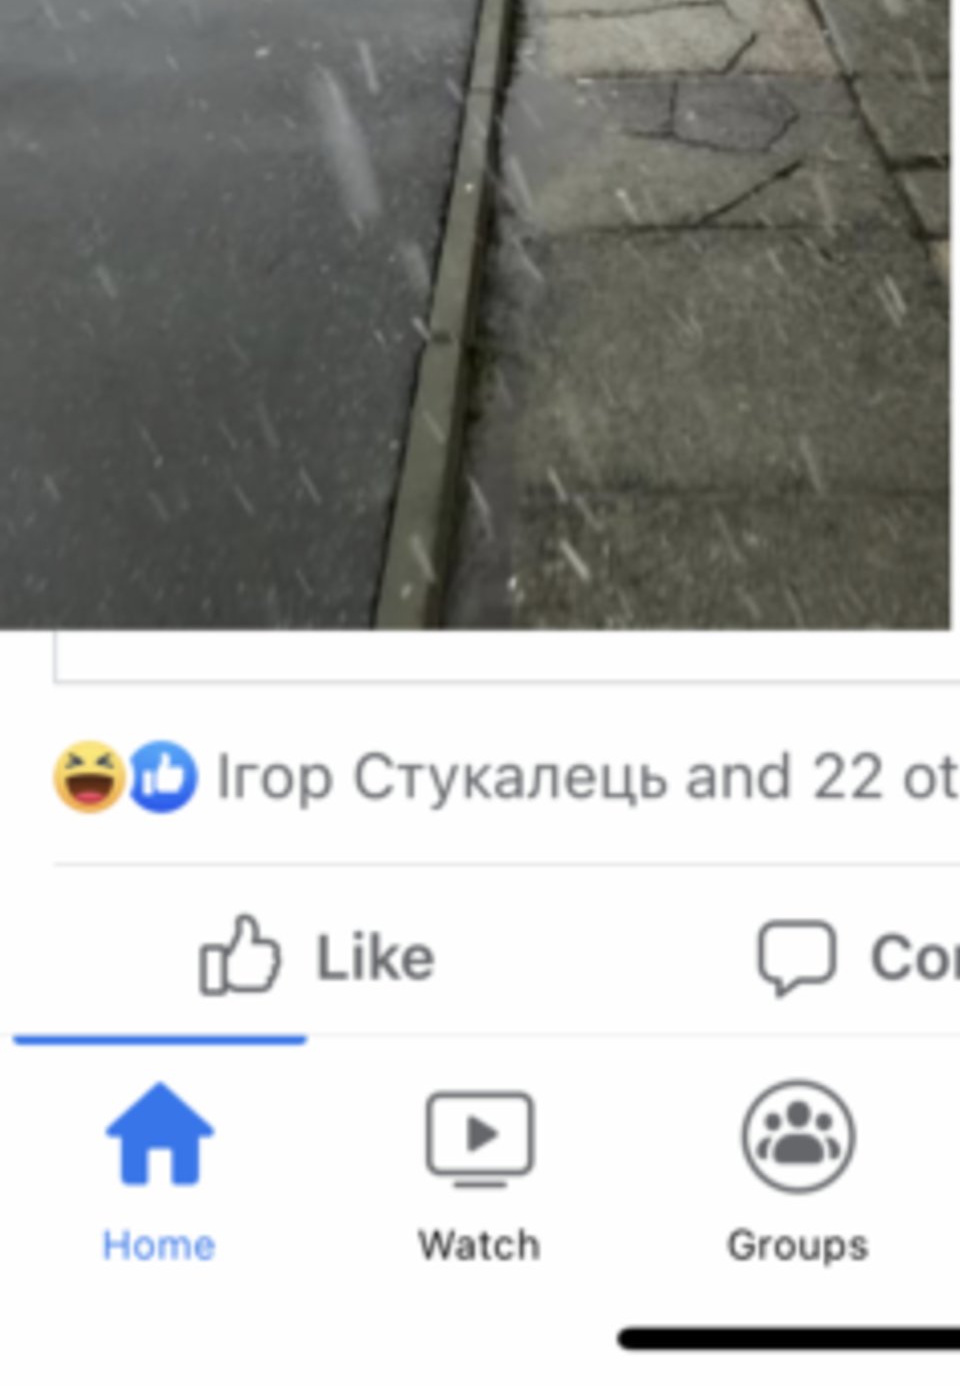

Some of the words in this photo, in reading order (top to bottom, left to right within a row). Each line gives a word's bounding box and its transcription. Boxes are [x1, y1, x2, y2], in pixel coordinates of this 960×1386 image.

[219, 752, 334, 810] Ігор
[354, 751, 668, 811] Стукалець
[686, 751, 790, 800] and
[814, 751, 883, 800] 22
[317, 930, 435, 982] Like
[104, 1230, 215, 1261] Home
[418, 1228, 540, 1261] Watch
[727, 1228, 869, 1267] Groups
